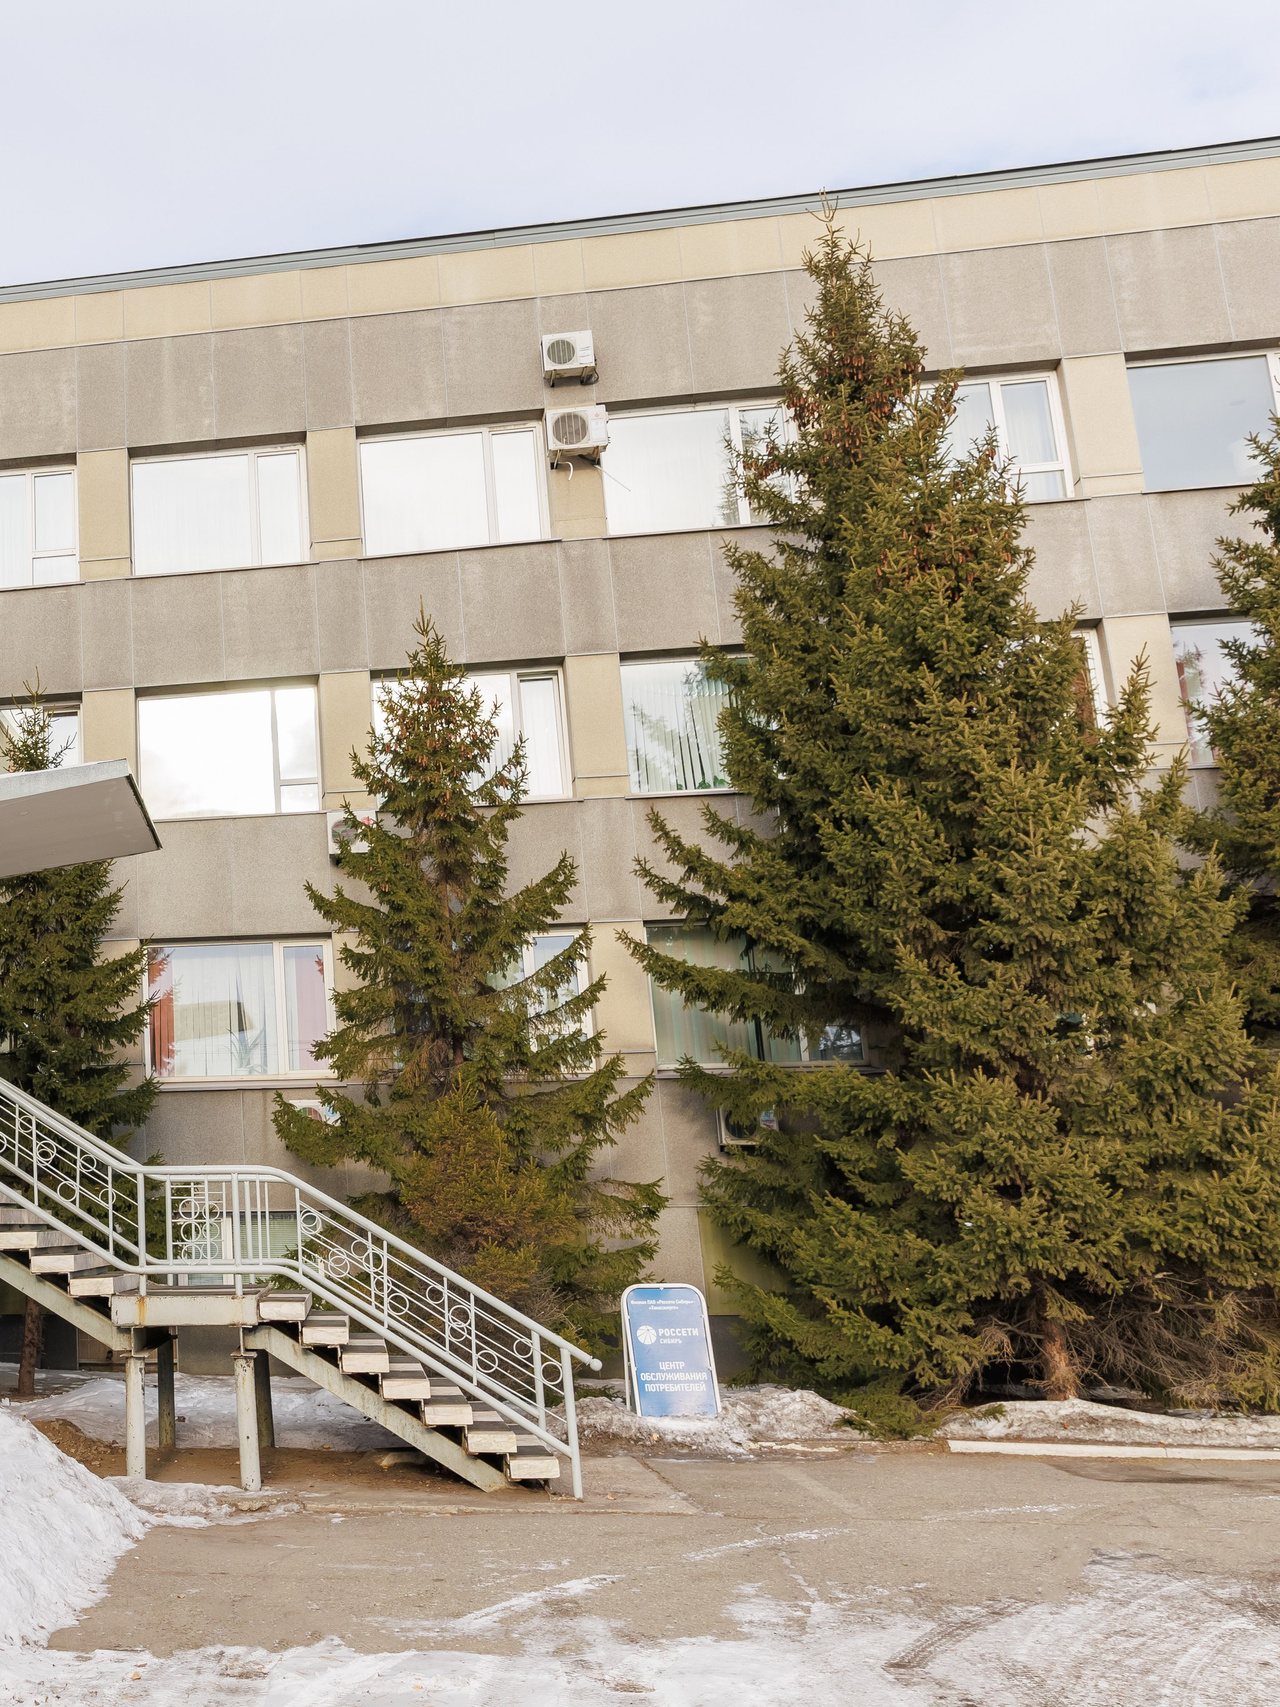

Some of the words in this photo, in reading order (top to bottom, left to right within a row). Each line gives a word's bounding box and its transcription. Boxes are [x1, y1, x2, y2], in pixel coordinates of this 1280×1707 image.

[658, 1328, 699, 1337] РОССЕТИ
[659, 1361, 685, 1371] ЦЕНТР
[640, 1372, 708, 1381] ОБСЛУЖИВАНИЯ
[644, 1381, 706, 1392] ПОТРЕБИТЕЛЕЙ
